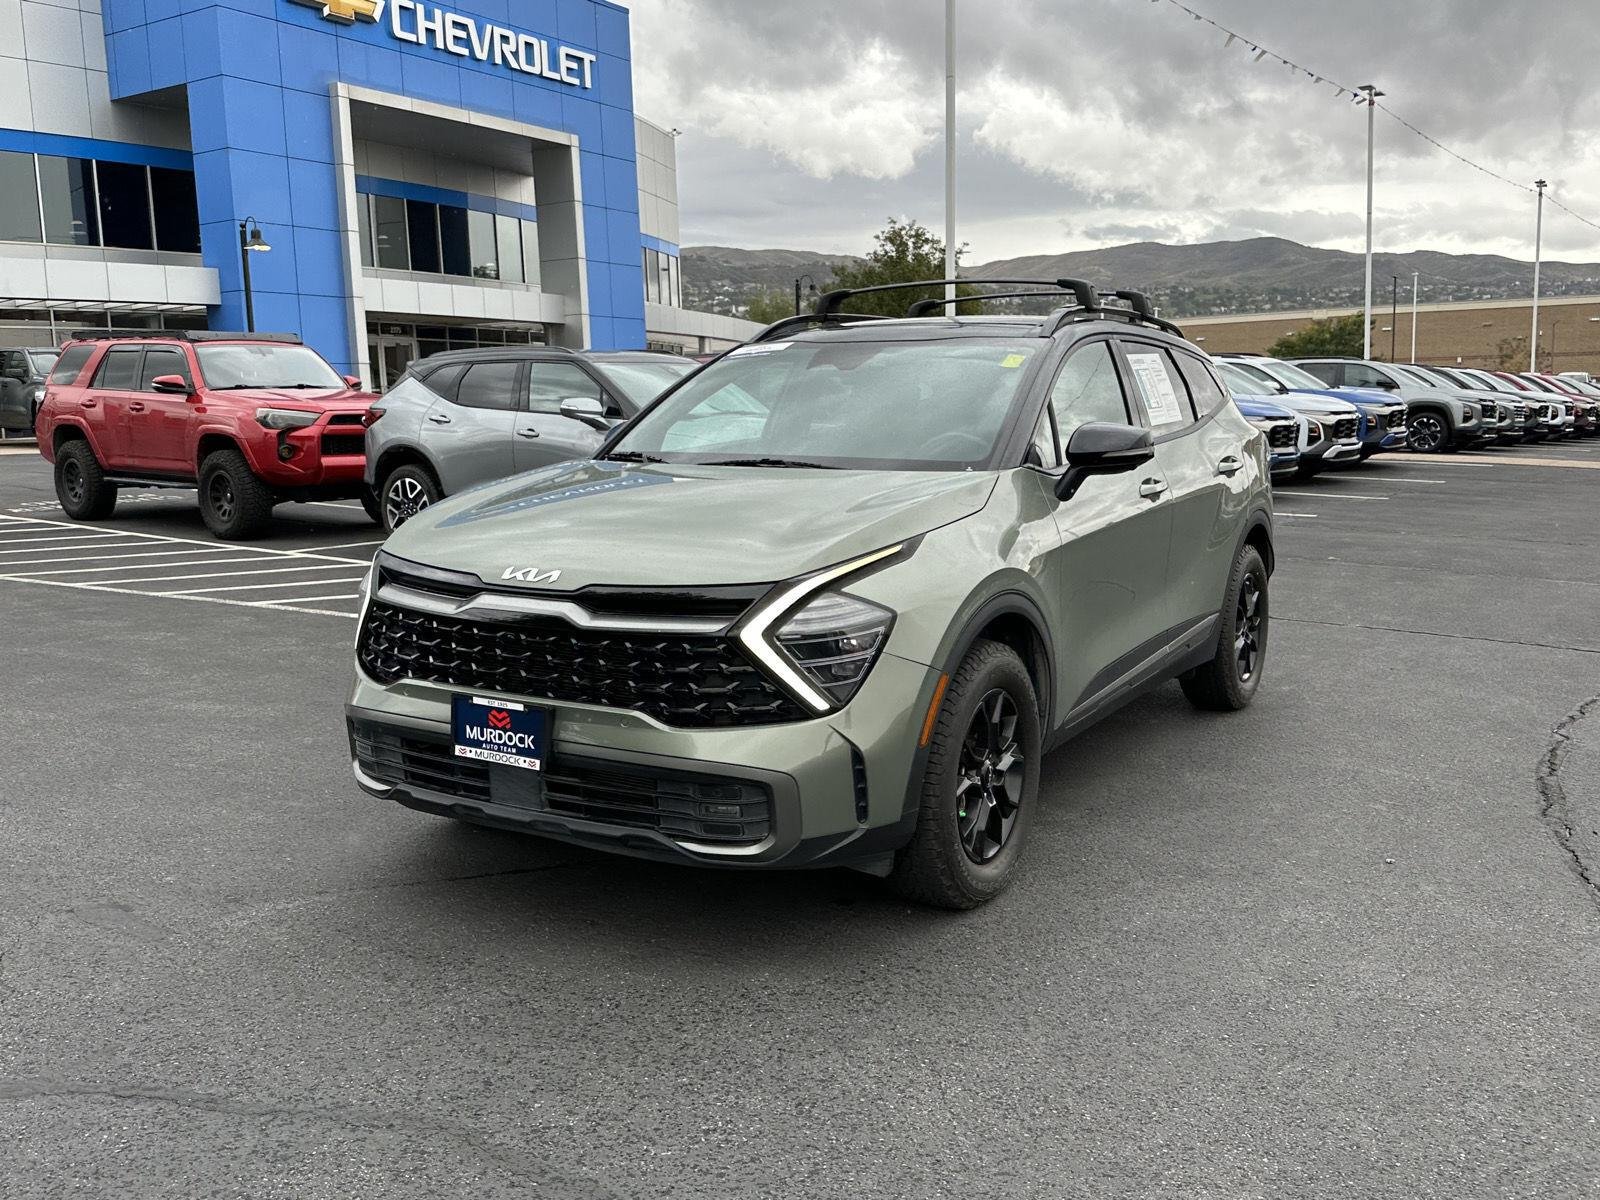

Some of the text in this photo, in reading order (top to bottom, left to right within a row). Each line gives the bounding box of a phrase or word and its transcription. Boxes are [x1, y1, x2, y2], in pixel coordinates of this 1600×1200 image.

[391, 0, 597, 89] CHEVROLET
[501, 566, 562, 583] KIA
[466, 725, 535, 750] MURDOCK
[482, 743, 516, 753] AUTO TEAM
[474, 750, 521, 765] MURDOCK
